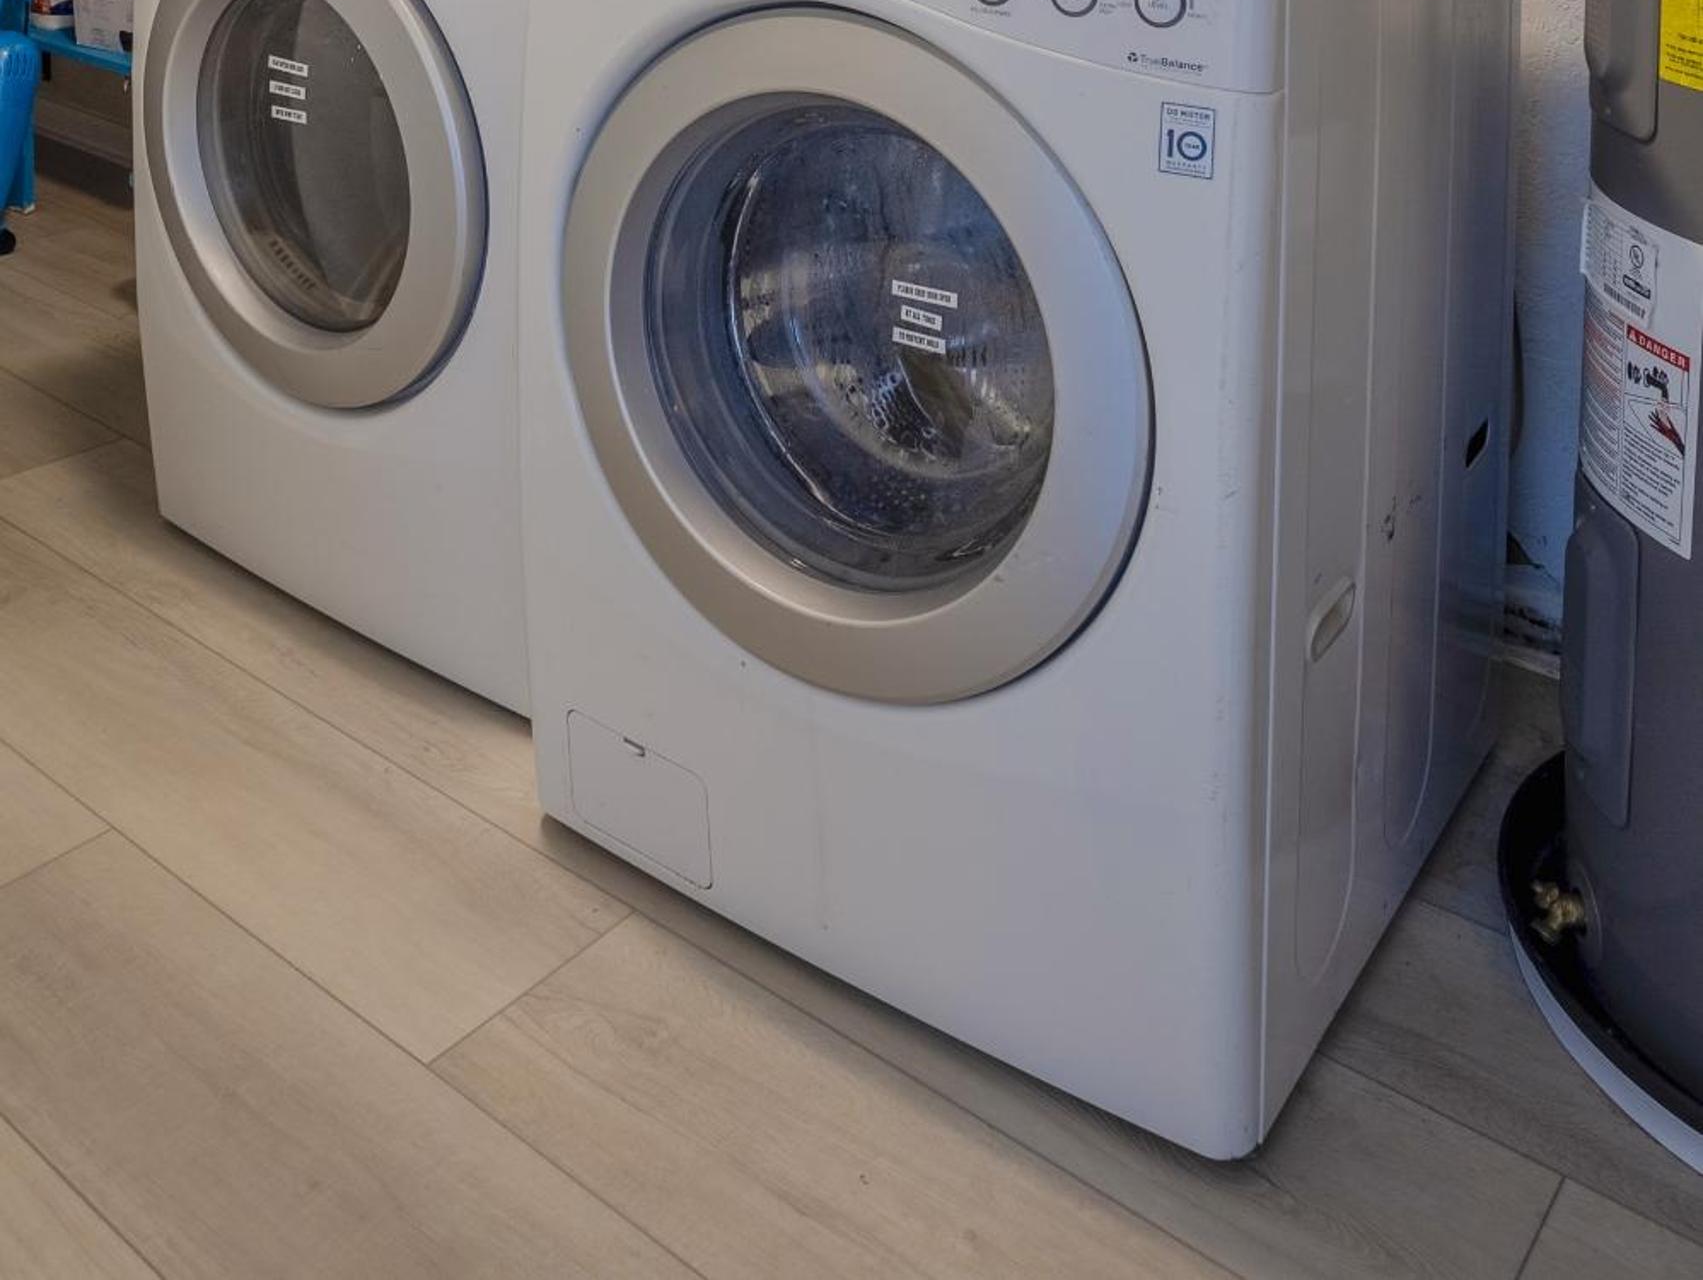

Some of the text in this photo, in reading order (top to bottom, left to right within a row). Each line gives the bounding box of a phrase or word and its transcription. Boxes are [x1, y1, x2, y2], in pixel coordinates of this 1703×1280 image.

[1140, 53, 1204, 72] TrueBalance
[1167, 128, 1208, 162] 10
[1639, 335, 1686, 369] DANGER
